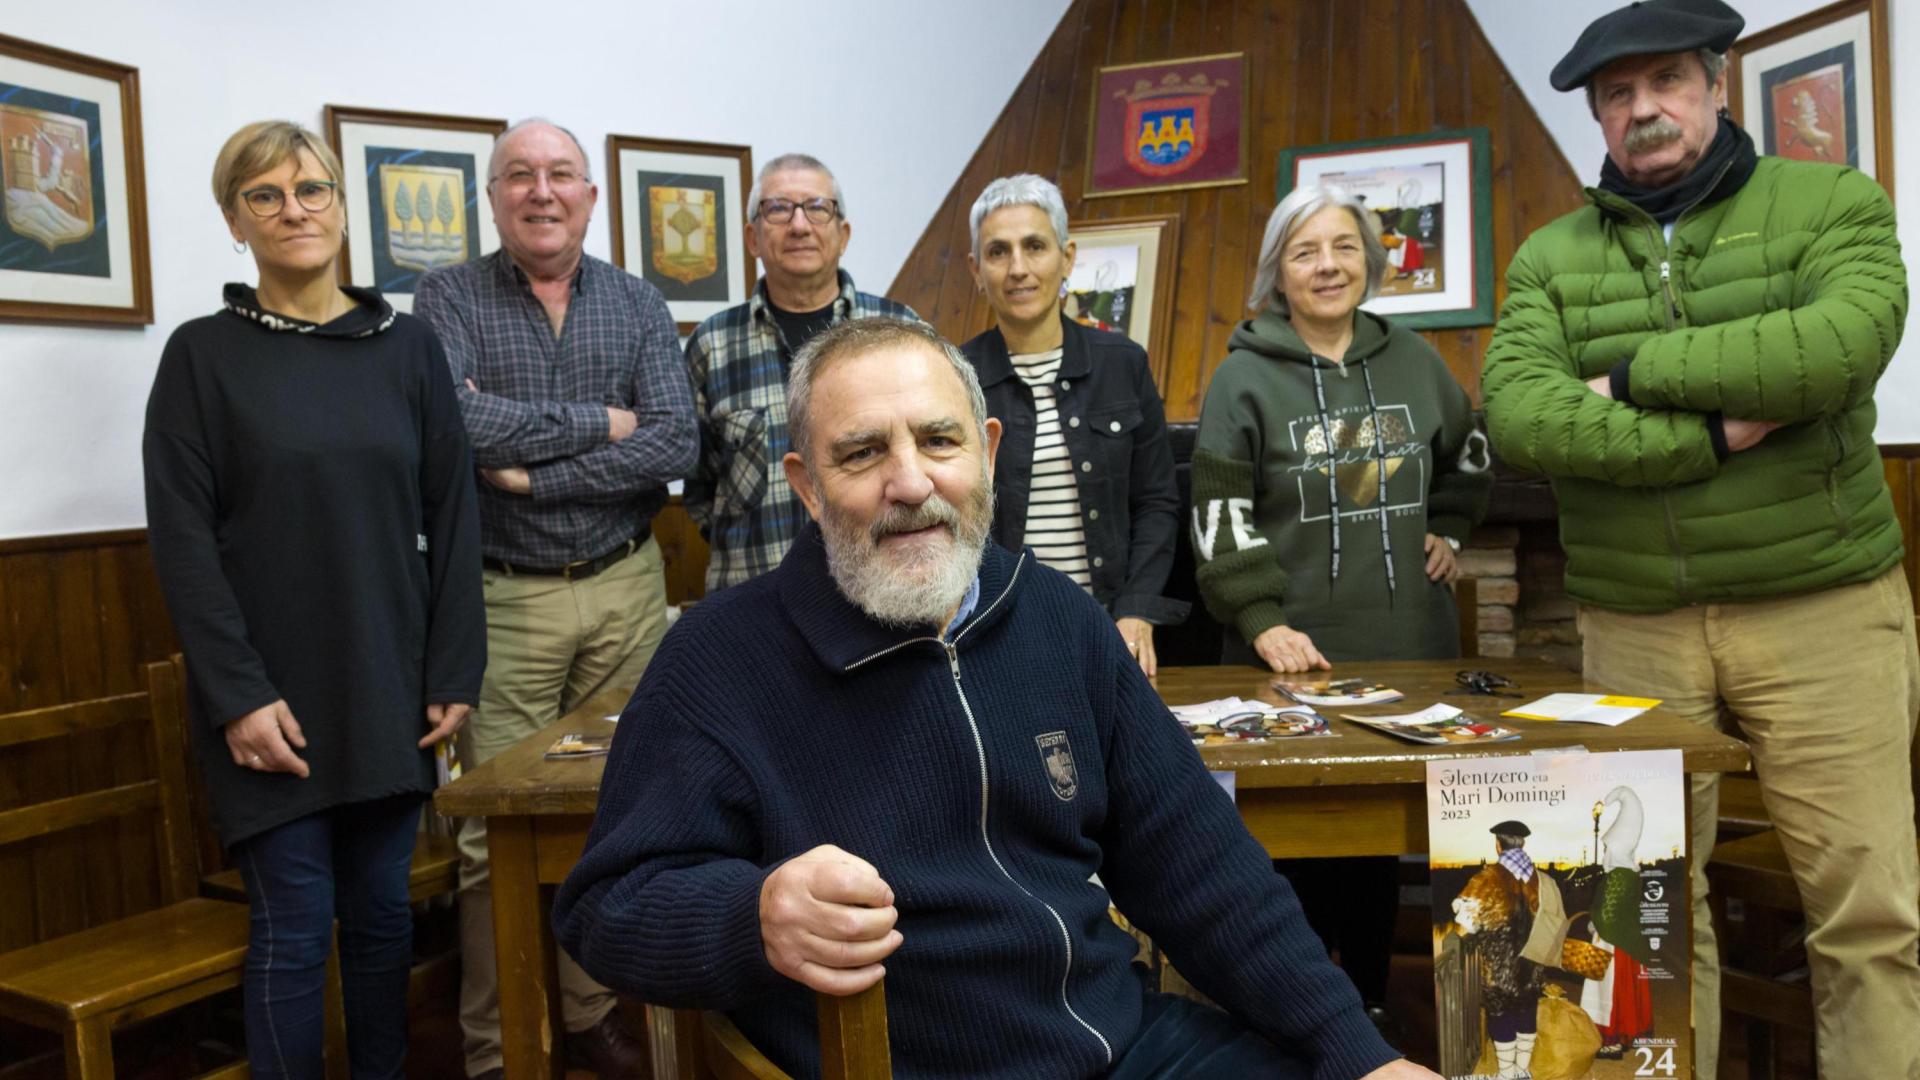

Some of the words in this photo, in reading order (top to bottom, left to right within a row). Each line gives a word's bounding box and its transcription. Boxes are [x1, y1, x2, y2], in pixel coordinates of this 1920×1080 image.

[1334, 404, 1371, 417] SPIRIT
[1362, 442, 1425, 461] hart
[1192, 498, 1268, 560] VE
[1440, 769, 1529, 787] Olentzero
[1532, 774, 1549, 783] eta
[1440, 788, 1481, 807] Mari
[1488, 785, 1567, 807] Domingi
[1440, 809, 1472, 821] 2023
[1635, 1047, 1677, 1076] 24
